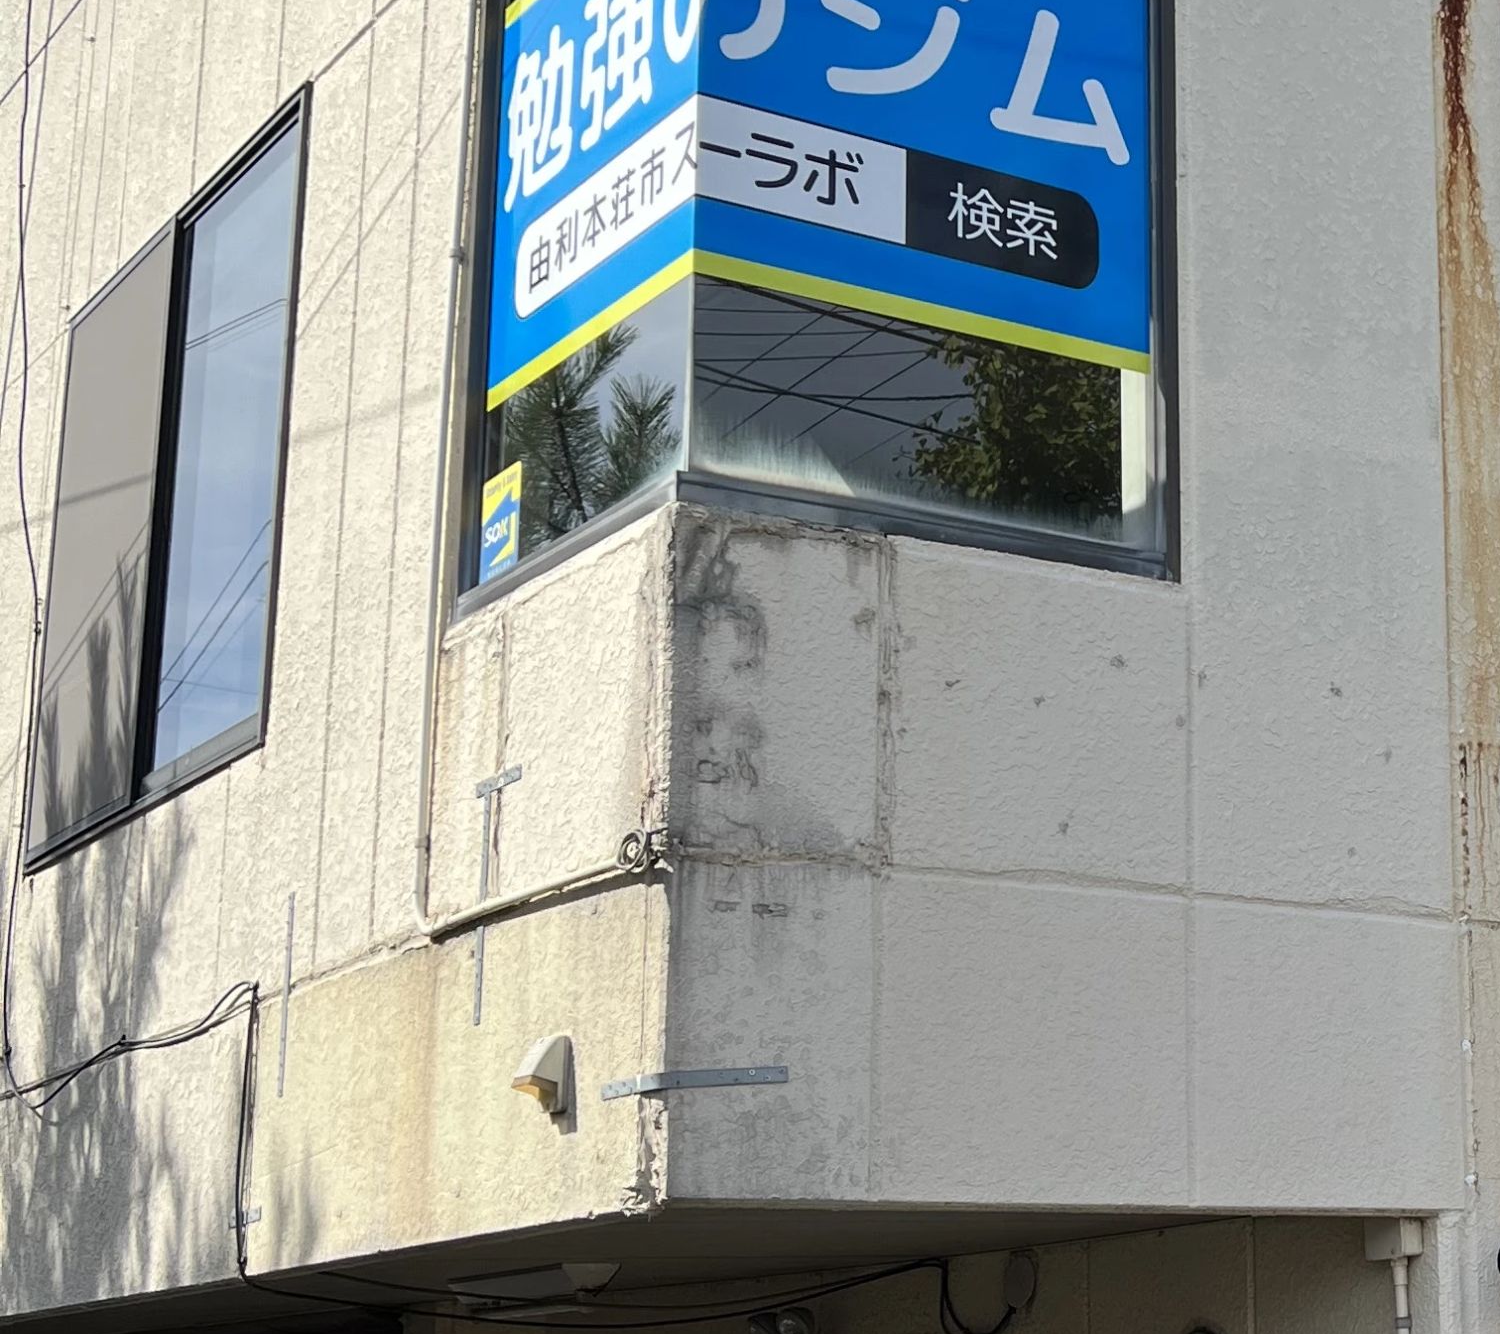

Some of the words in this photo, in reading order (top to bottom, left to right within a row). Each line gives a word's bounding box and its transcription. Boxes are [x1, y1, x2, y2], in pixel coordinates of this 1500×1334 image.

[528, 120, 865, 294] 由利本荘市スーラボ
[947, 182, 1059, 261] 検索
